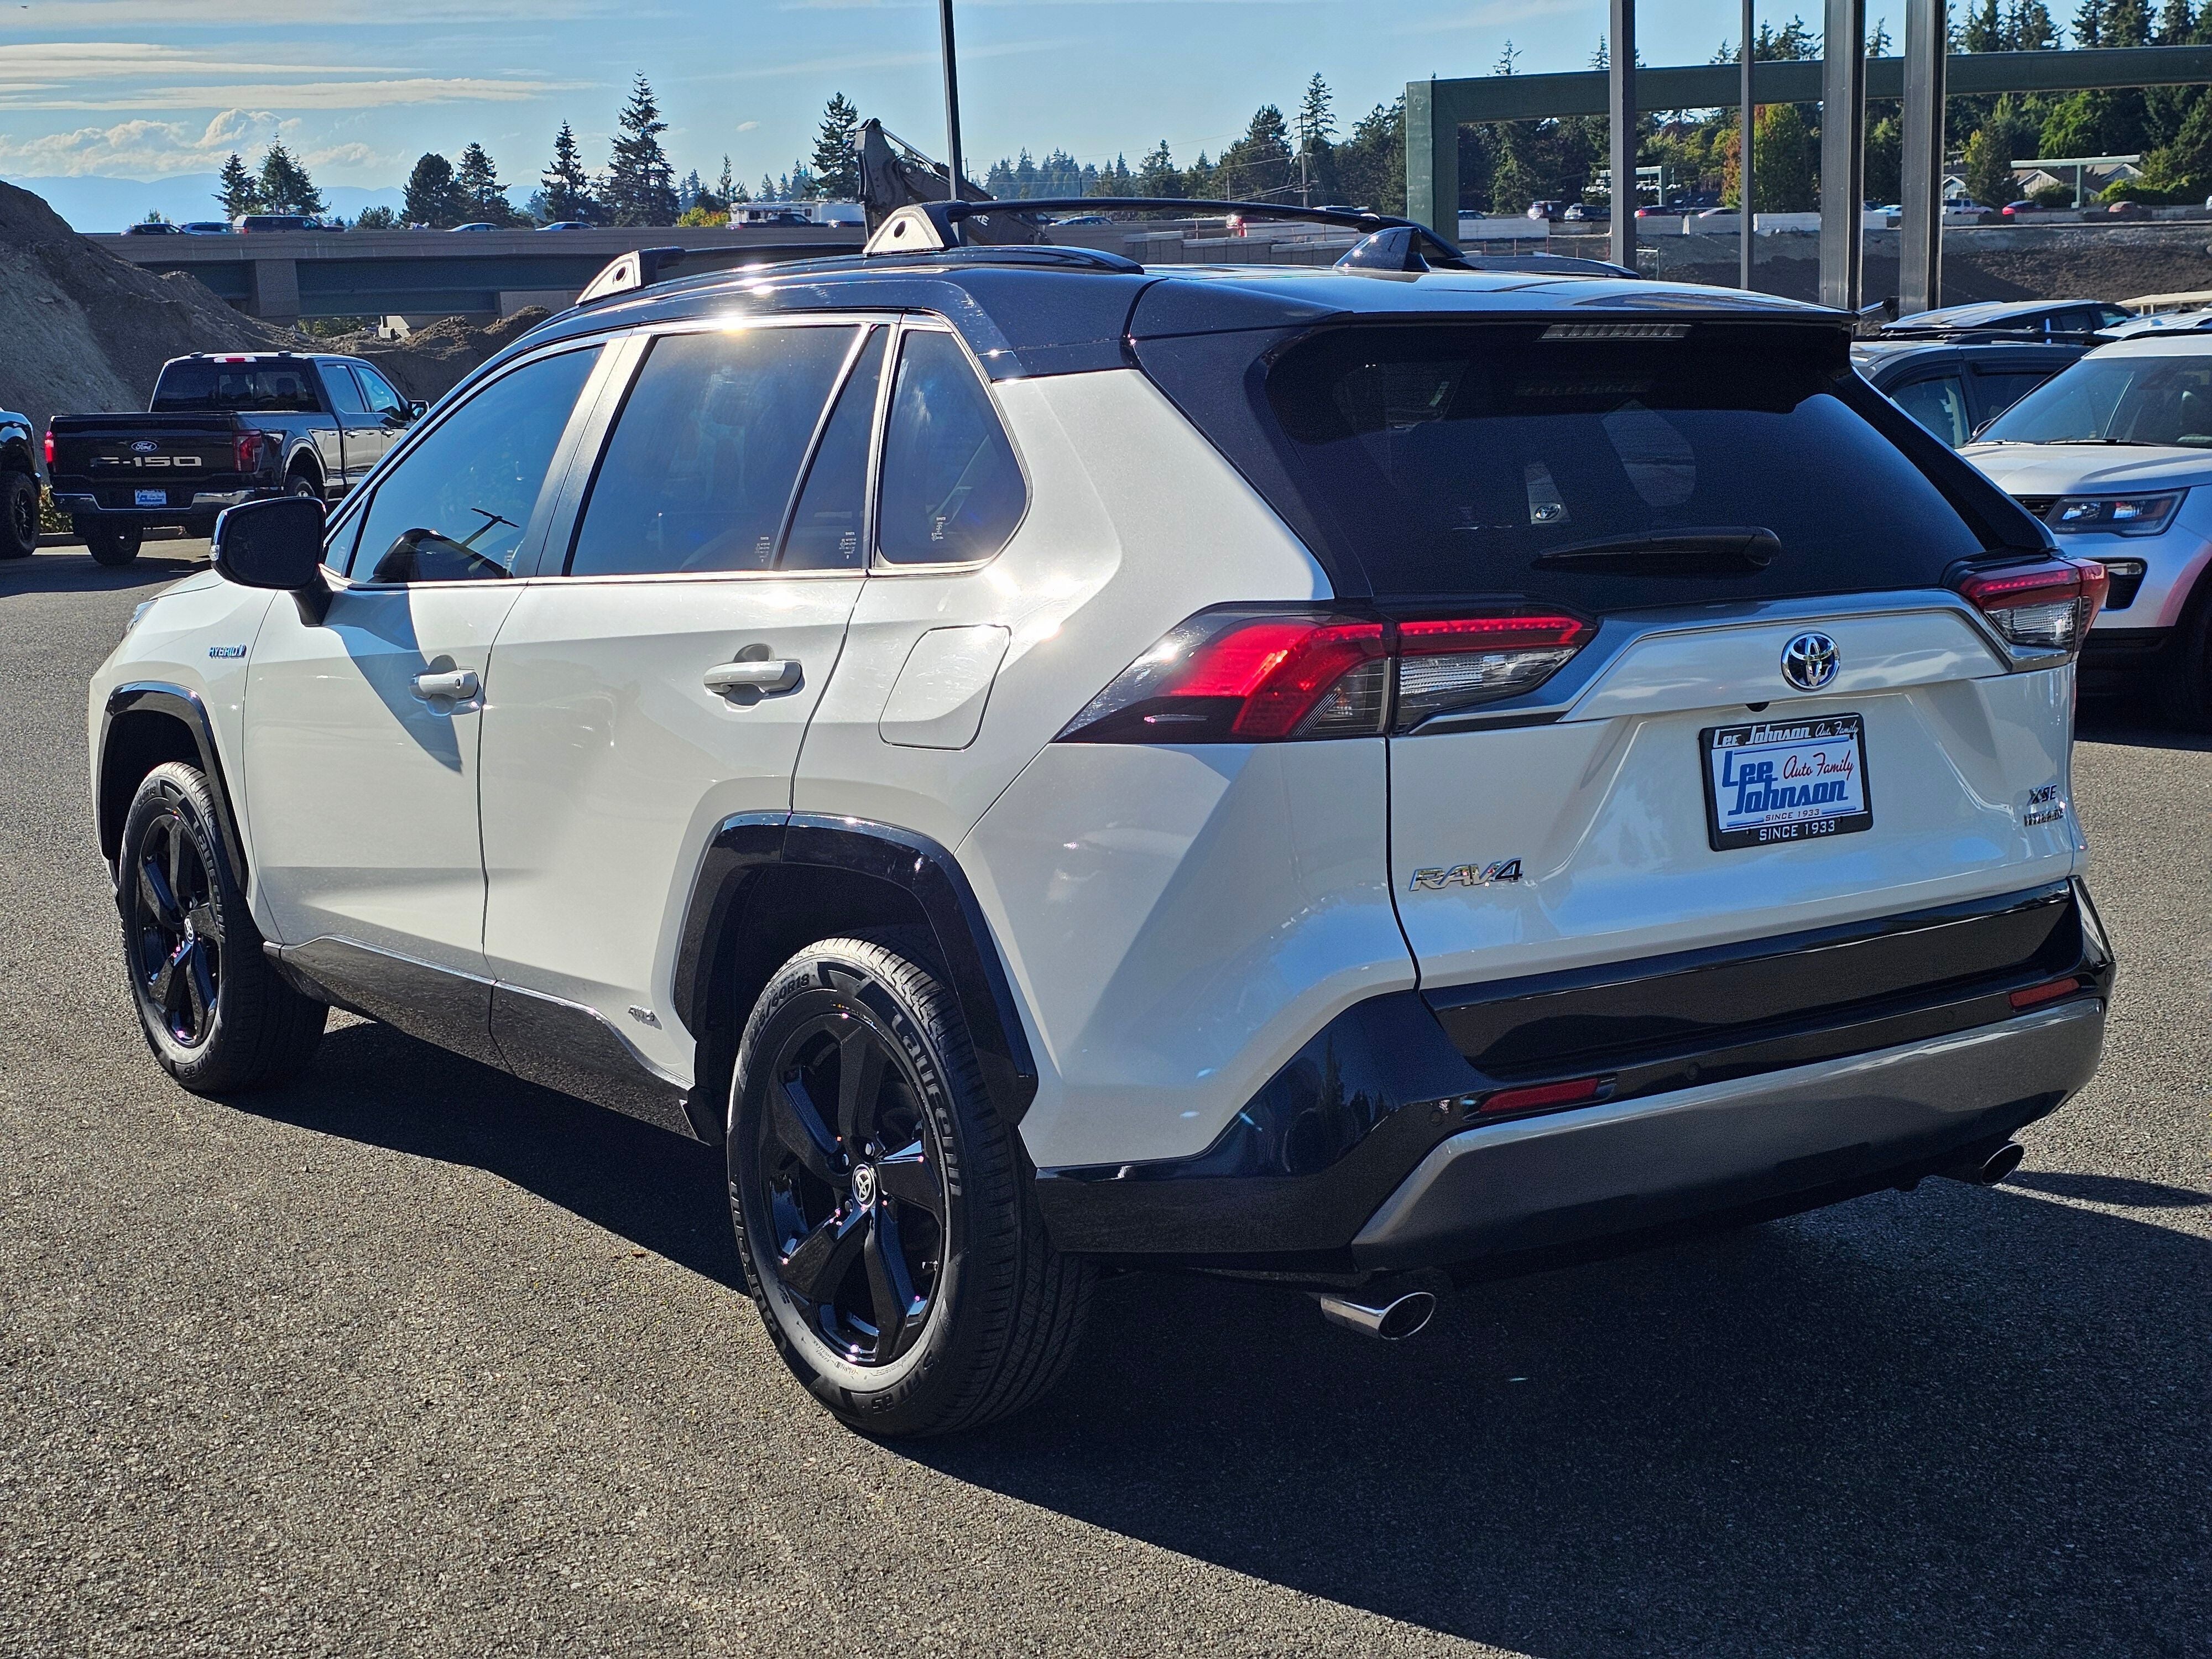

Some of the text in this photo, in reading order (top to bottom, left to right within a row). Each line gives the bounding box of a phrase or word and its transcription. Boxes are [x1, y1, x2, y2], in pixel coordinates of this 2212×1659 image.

[90, 456, 202, 467] F-150
[1745, 724, 1811, 745] Johnson
[1834, 719, 1859, 738] Family
[1721, 749, 1854, 787] Lee Auto Family
[1728, 776, 1849, 816] Johnson
[2026, 784, 2057, 806] XSE
[1765, 808, 1820, 822] SINCE 1933
[1759, 821, 1835, 841] SINCE 1933
[1408, 857, 1524, 891] RAV4
